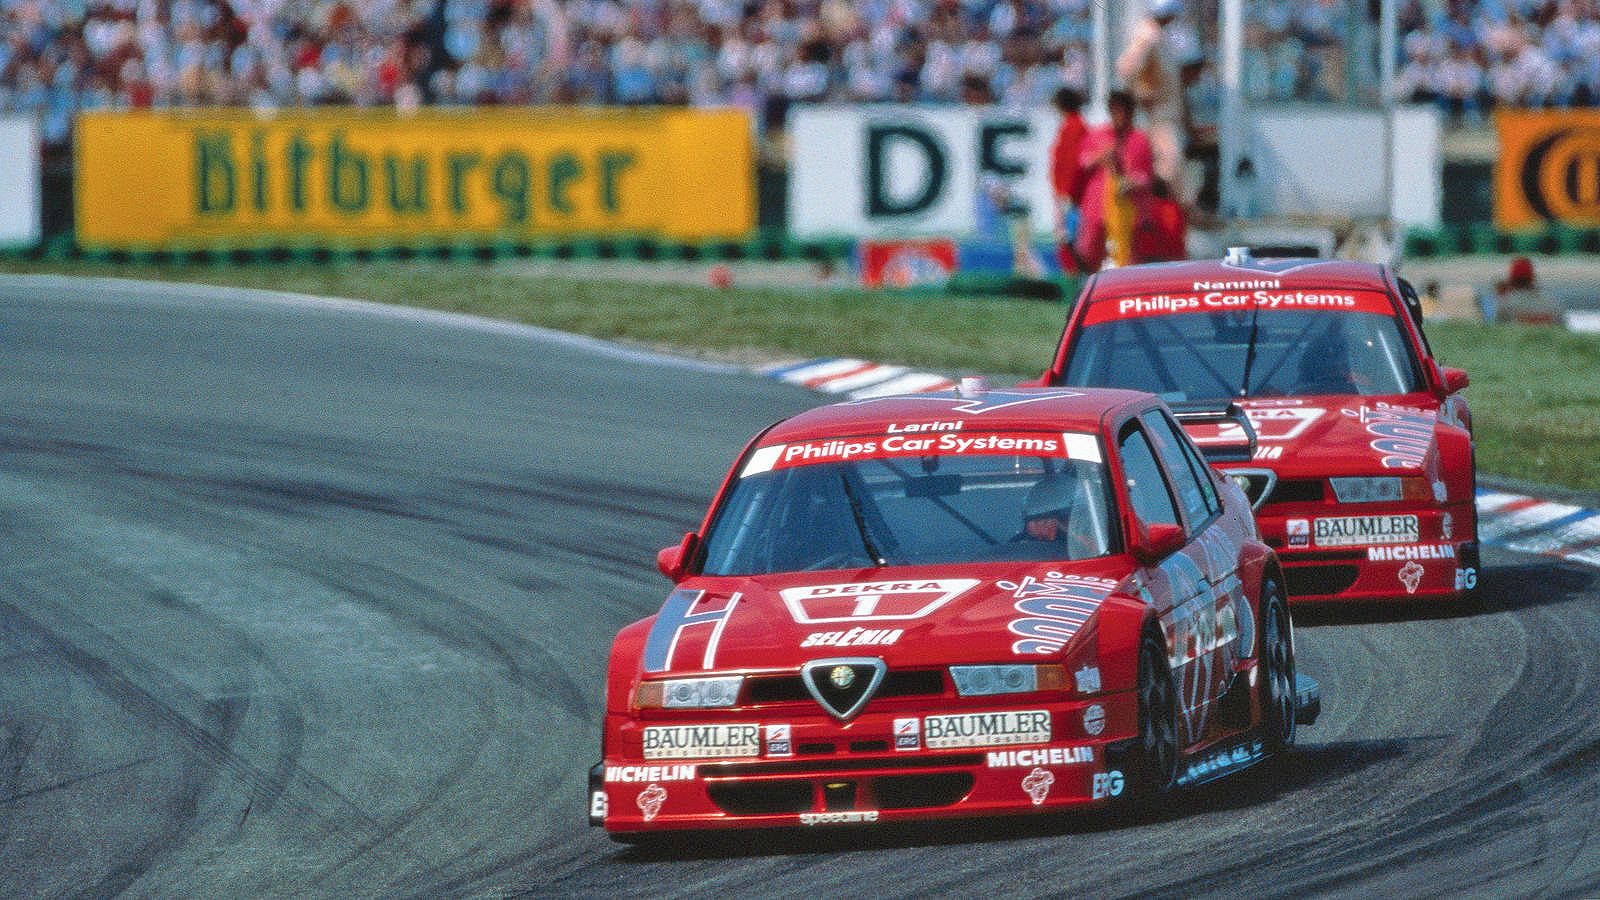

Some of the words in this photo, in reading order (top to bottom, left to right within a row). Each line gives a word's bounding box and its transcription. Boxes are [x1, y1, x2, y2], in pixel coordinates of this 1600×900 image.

[194, 127, 638, 223] Bitburger
[1193, 279, 1281, 290] Nannini
[1119, 296, 1199, 314] Philips
[1204, 292, 1249, 306] Car
[1253, 291, 1355, 308] Systems
[888, 421, 963, 433] Larini
[785, 440, 876, 461] Philips
[882, 436, 931, 452] Car
[938, 434, 1058, 455] Systems
[1368, 545, 1454, 561] MICHELIN
[811, 582, 942, 596] DEKRA
[852, 594, 883, 616] 1
[987, 747, 1093, 767] MICHELIN
